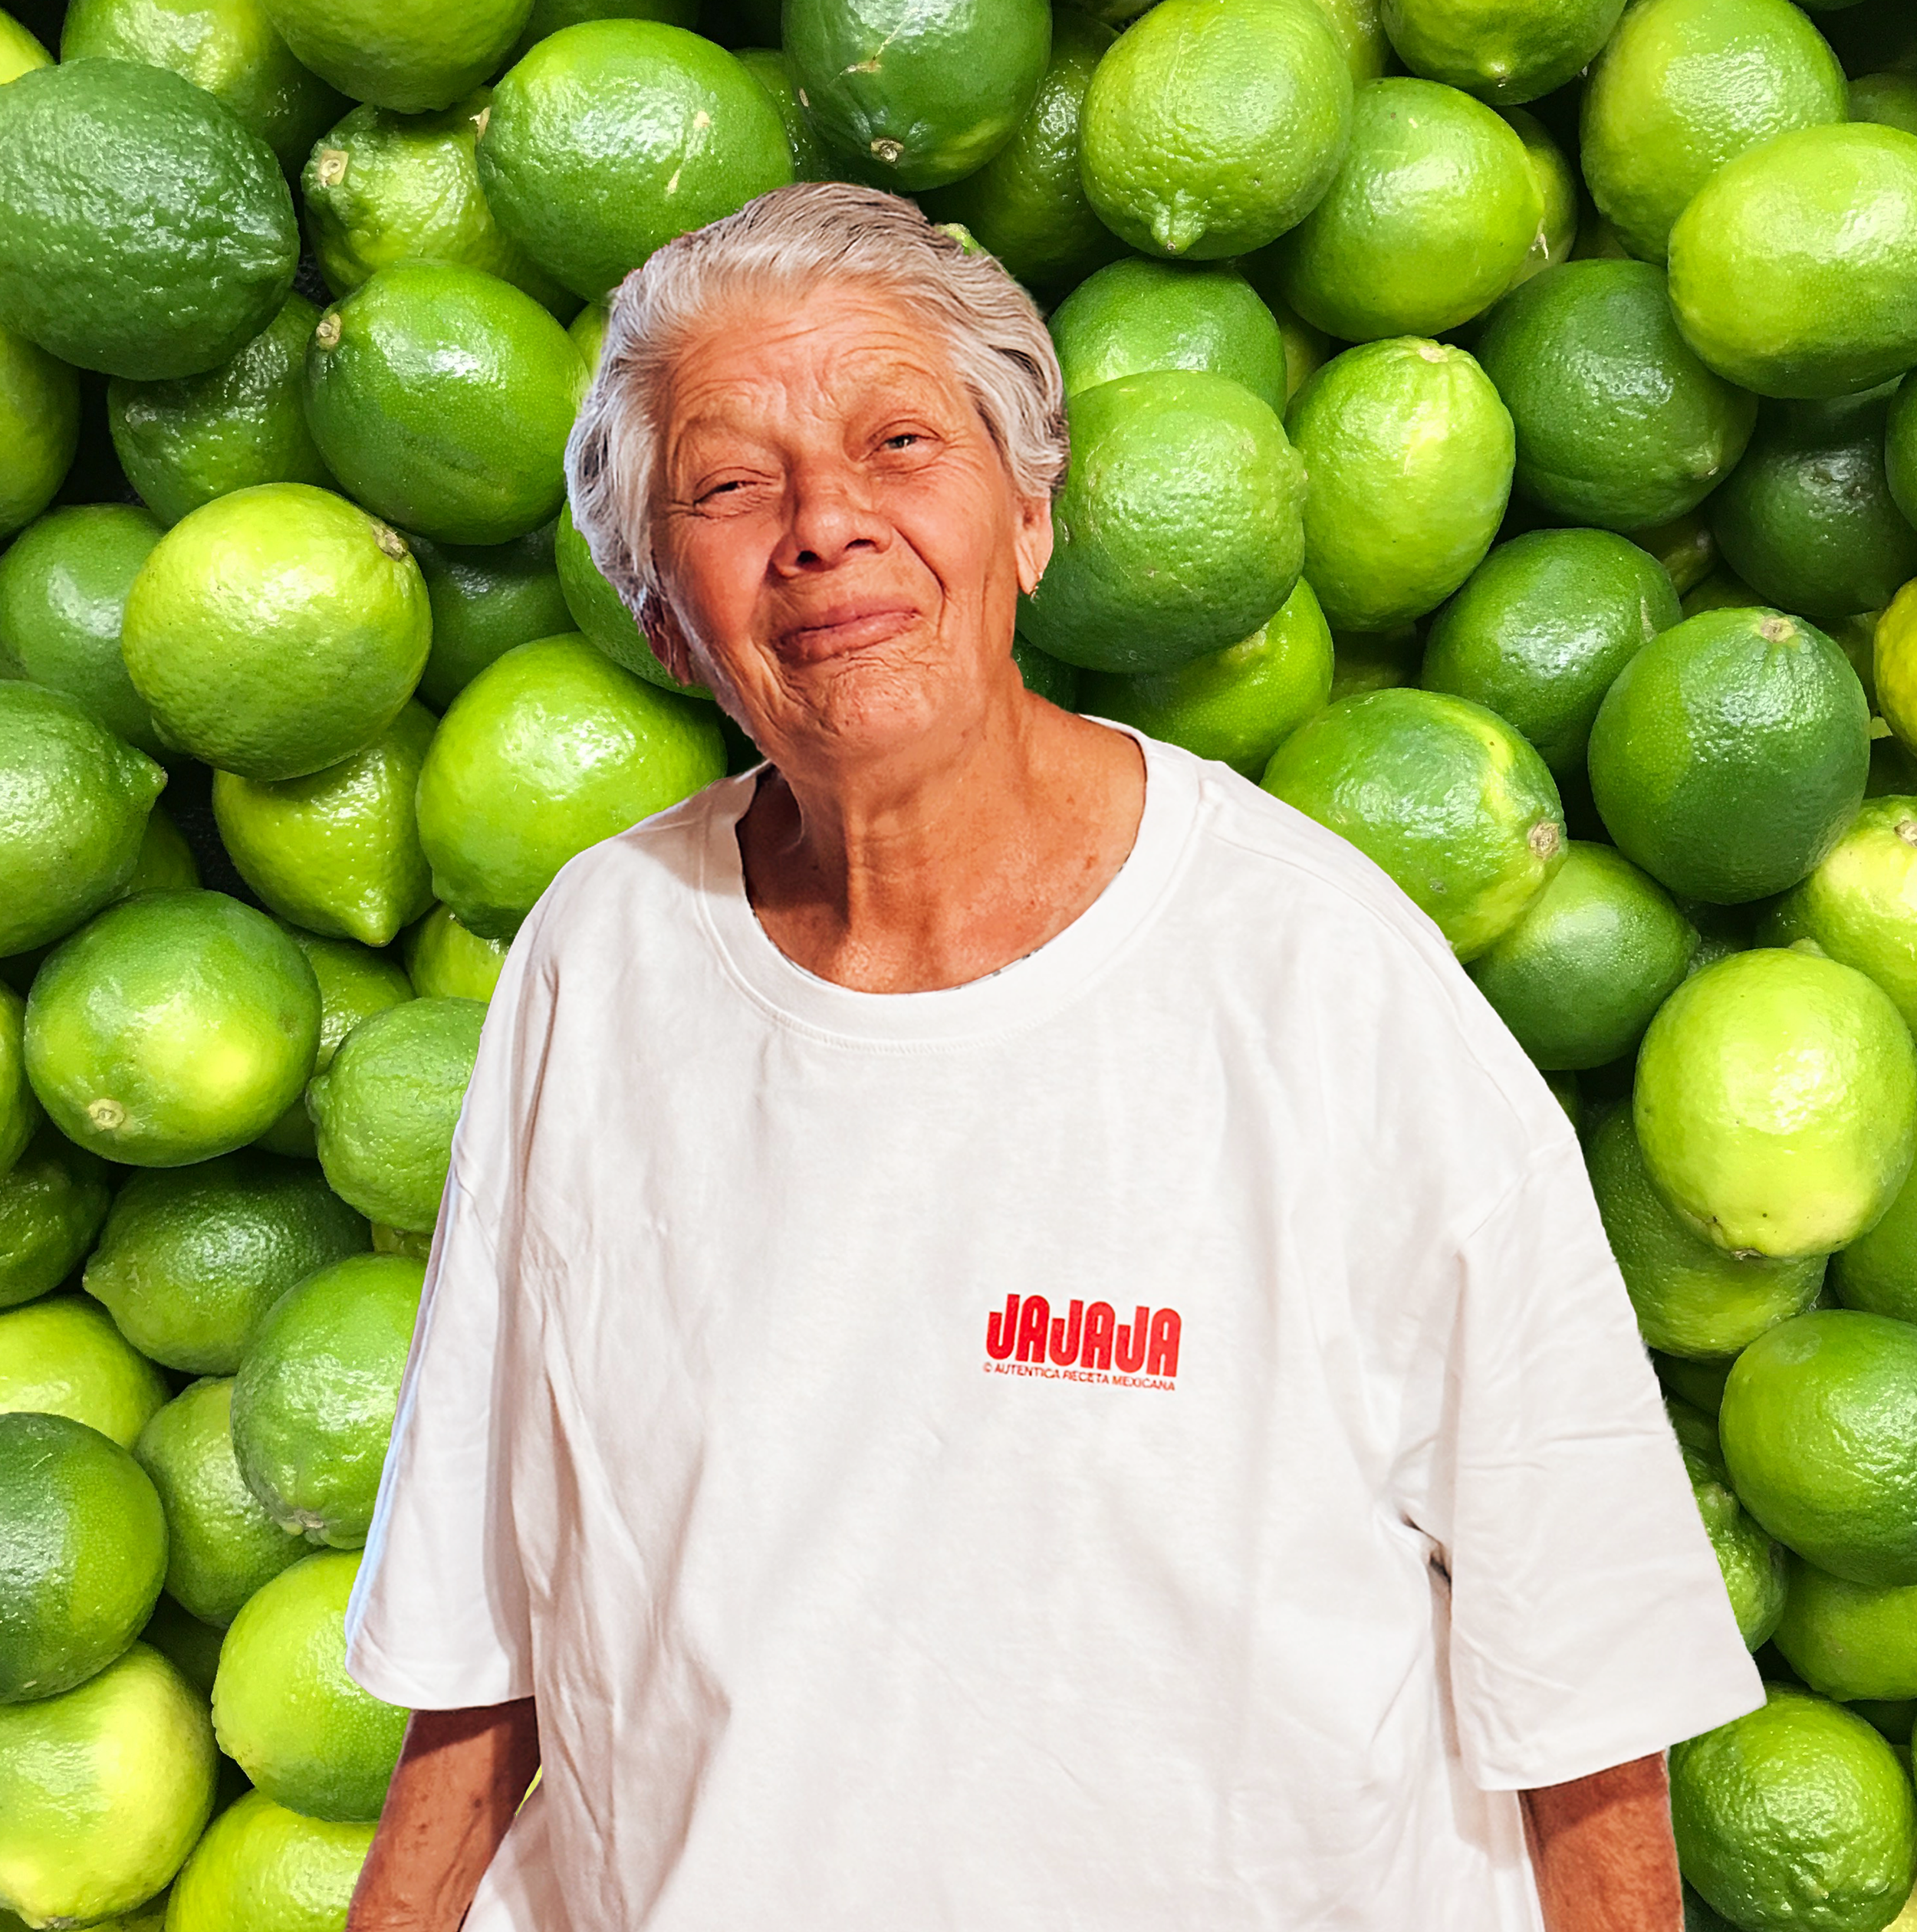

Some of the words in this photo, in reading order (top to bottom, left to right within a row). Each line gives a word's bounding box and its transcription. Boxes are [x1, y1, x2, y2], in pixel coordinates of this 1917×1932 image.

[985, 1293, 1182, 1378] JAJAJA
[994, 1363, 1061, 1379] AUTENTICA
[1062, 1369, 1110, 1385] RECETA
[1111, 1375, 1176, 1392] MEXICANA
